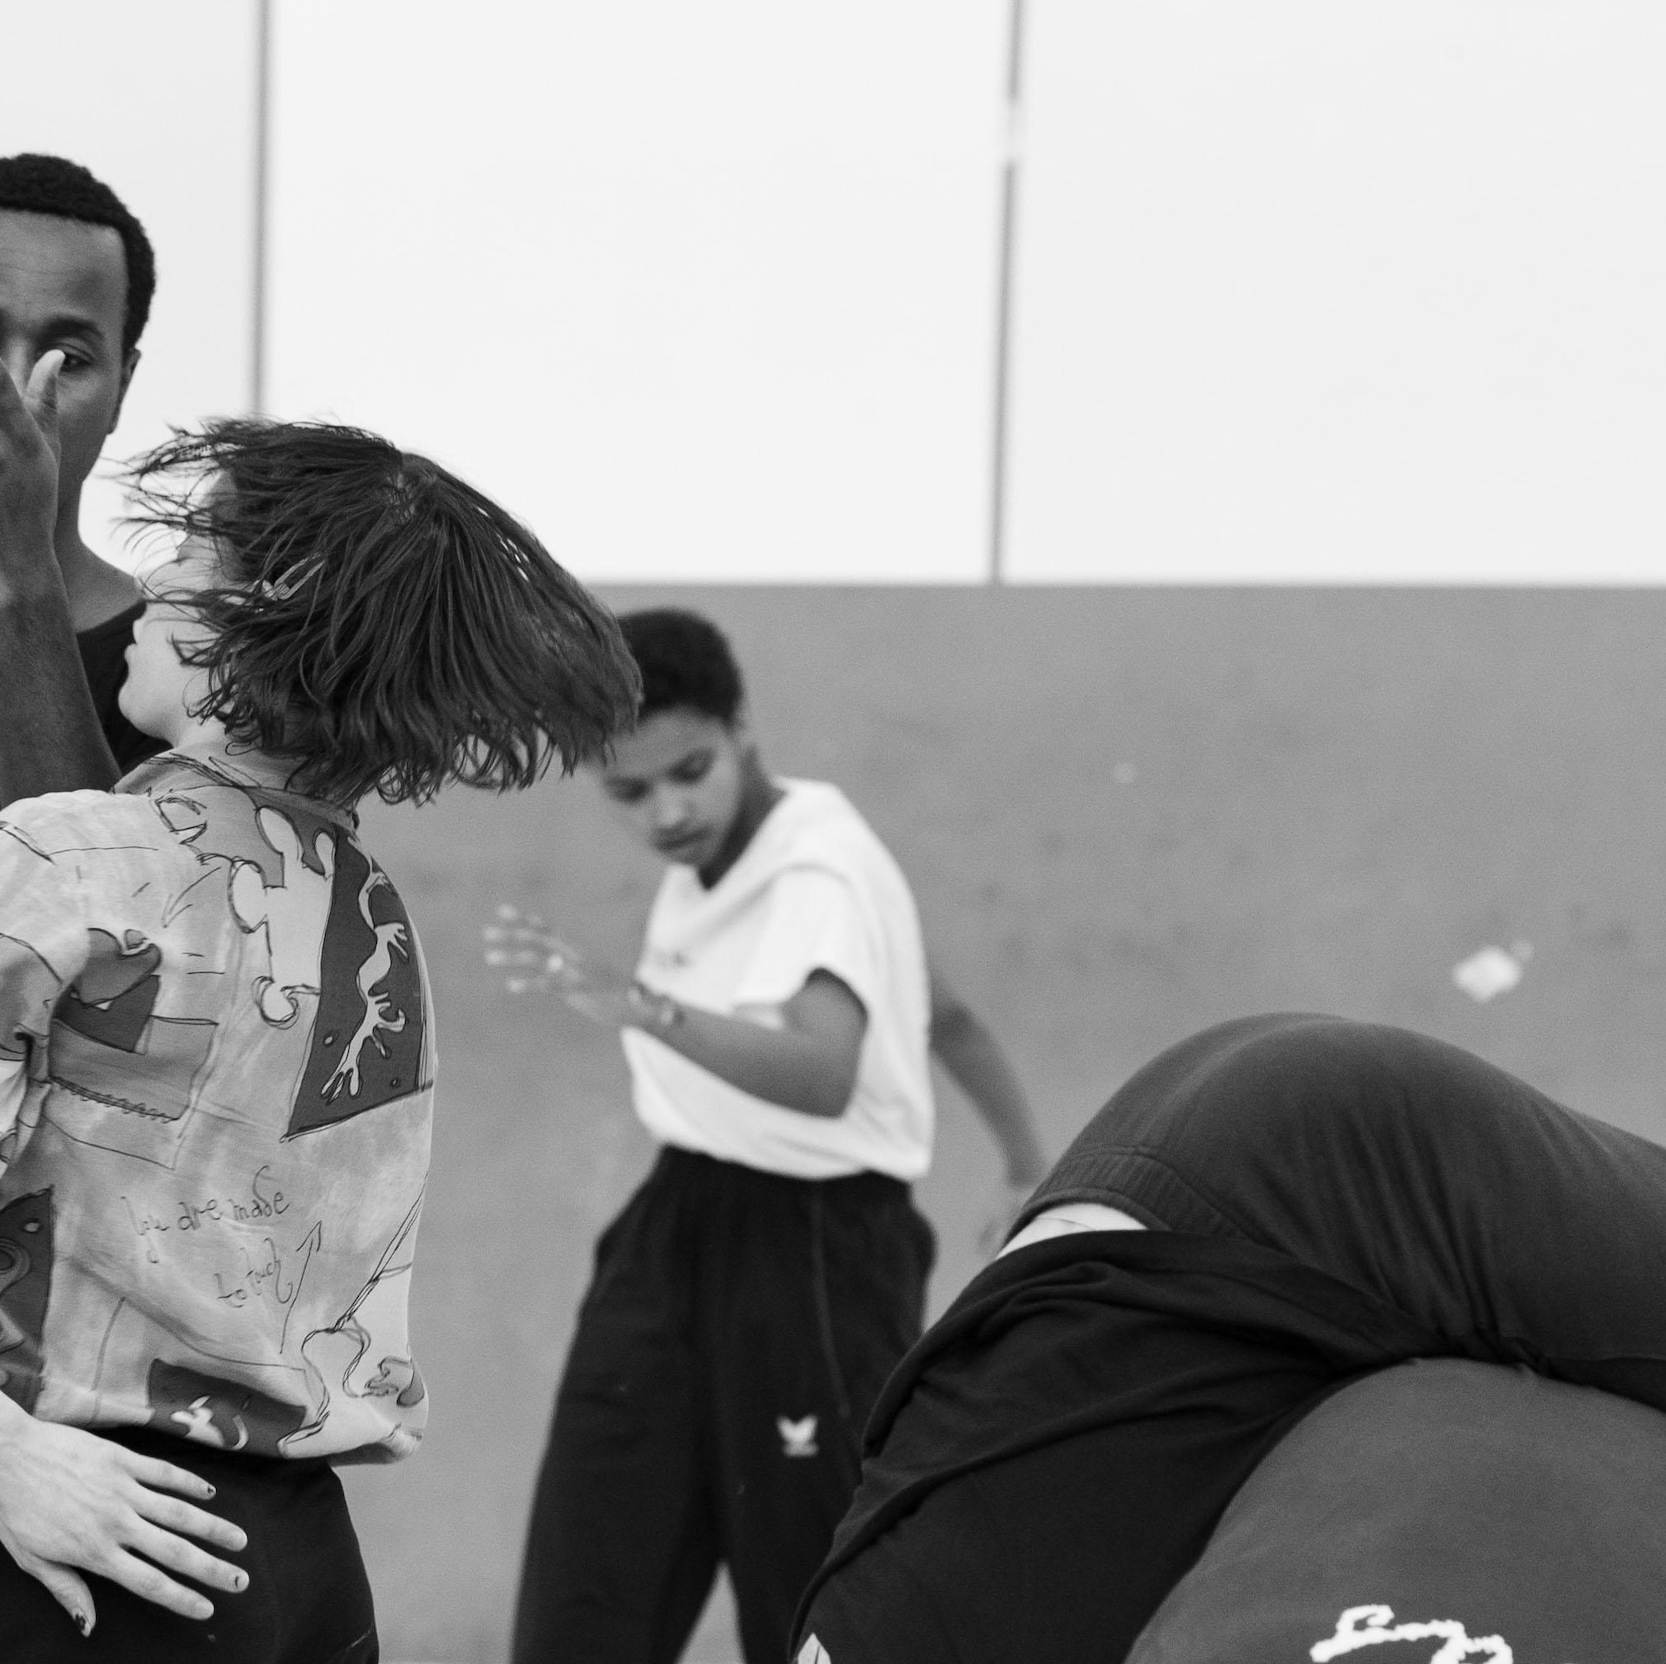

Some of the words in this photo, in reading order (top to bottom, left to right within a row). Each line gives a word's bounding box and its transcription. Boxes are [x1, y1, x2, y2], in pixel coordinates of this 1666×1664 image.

[177, 1199, 222, 1231] are
[227, 1164, 290, 1221] made
[212, 1272, 248, 1309] to
